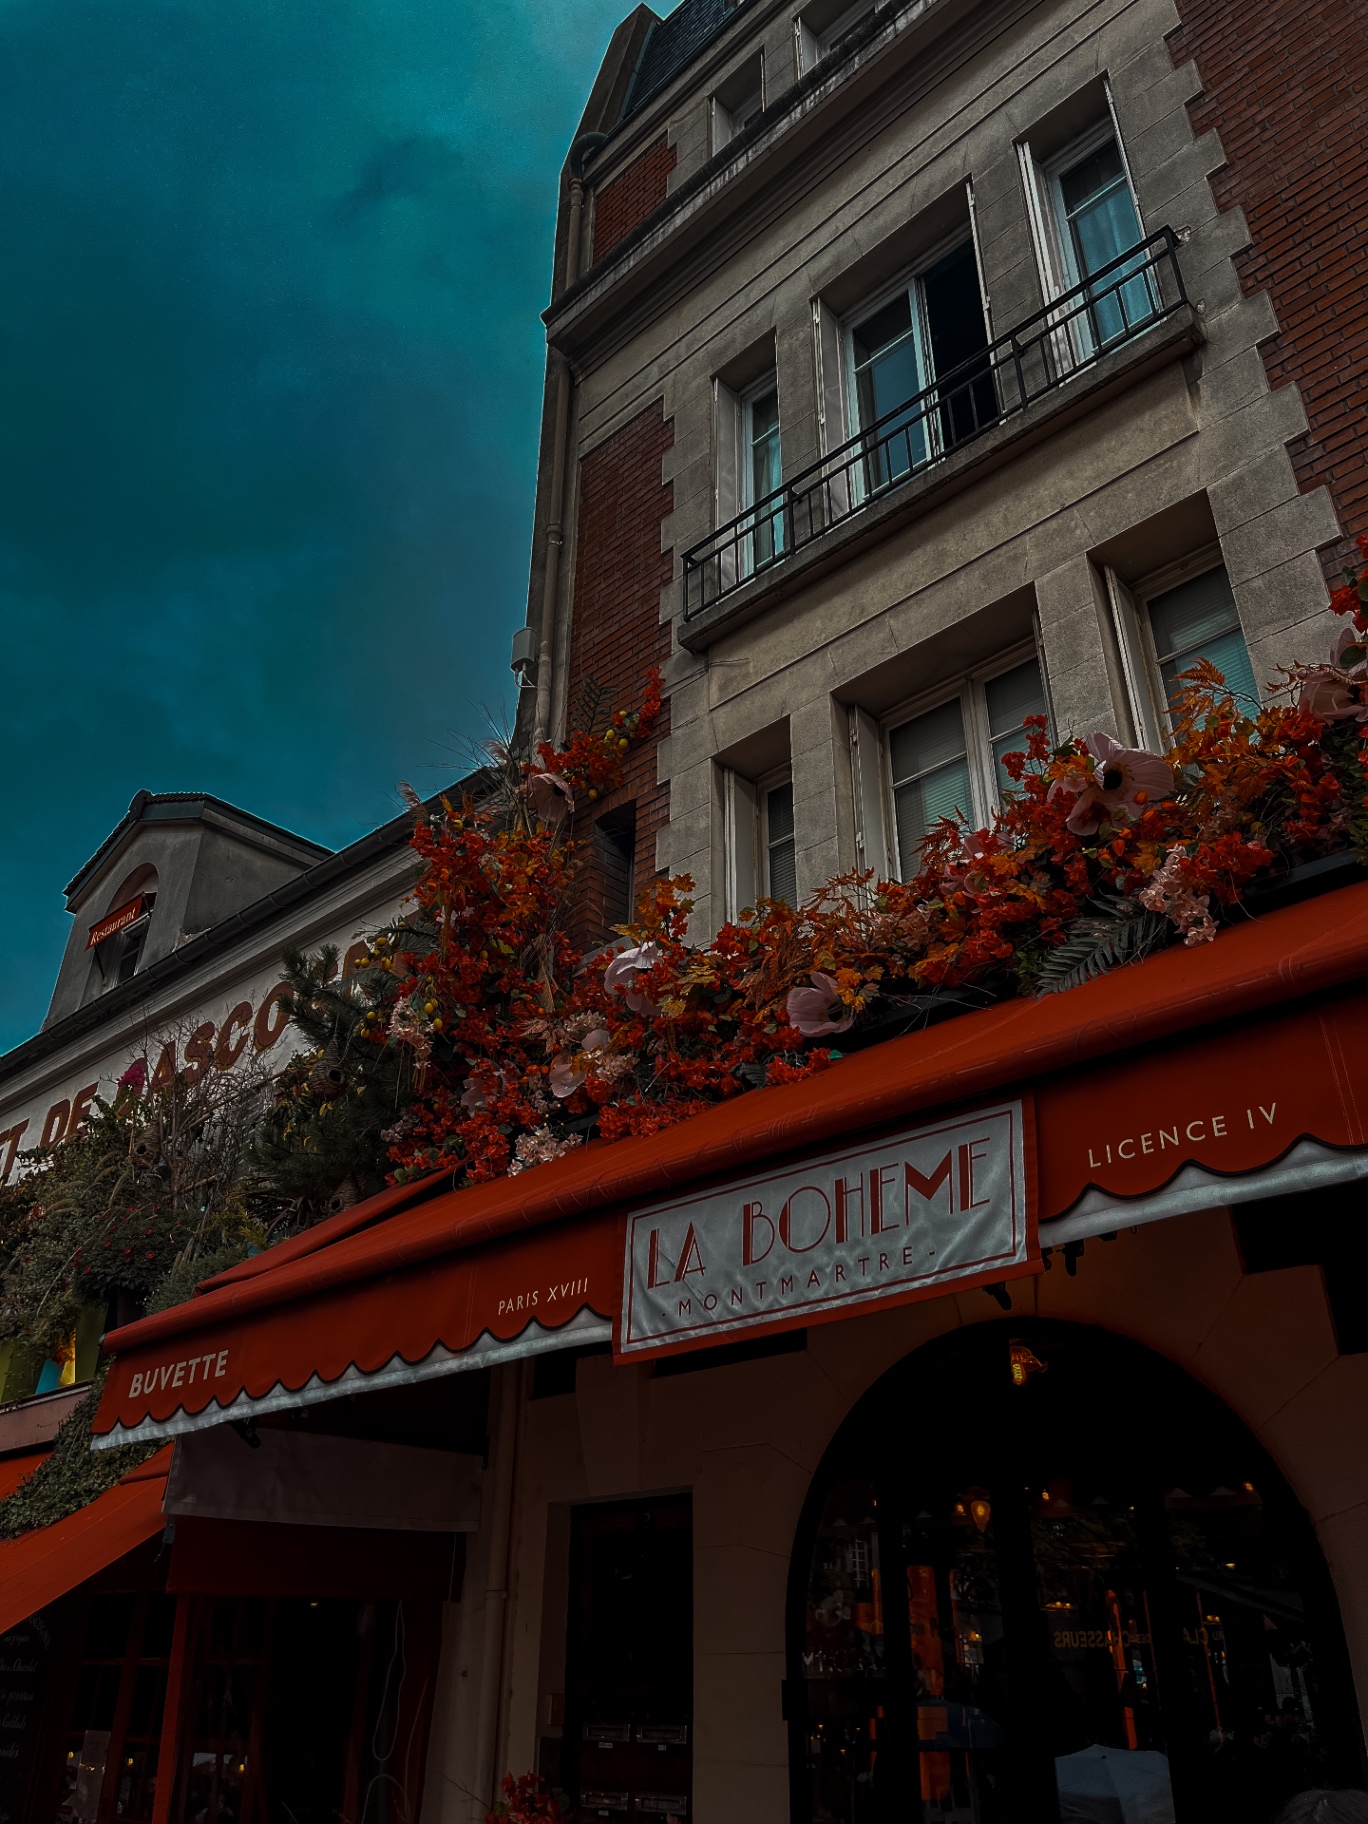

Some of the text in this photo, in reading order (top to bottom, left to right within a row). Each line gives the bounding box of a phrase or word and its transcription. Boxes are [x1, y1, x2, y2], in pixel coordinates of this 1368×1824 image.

[89, 907, 136, 946] Restaurant
[1088, 1102, 1277, 1168] LICENCE IV
[647, 1137, 991, 1289] LA BOHEME
[498, 1277, 589, 1315] PARIS XVIII
[678, 1246, 913, 1317] MONTMARTRE
[128, 1350, 229, 1398] BUVETTE
